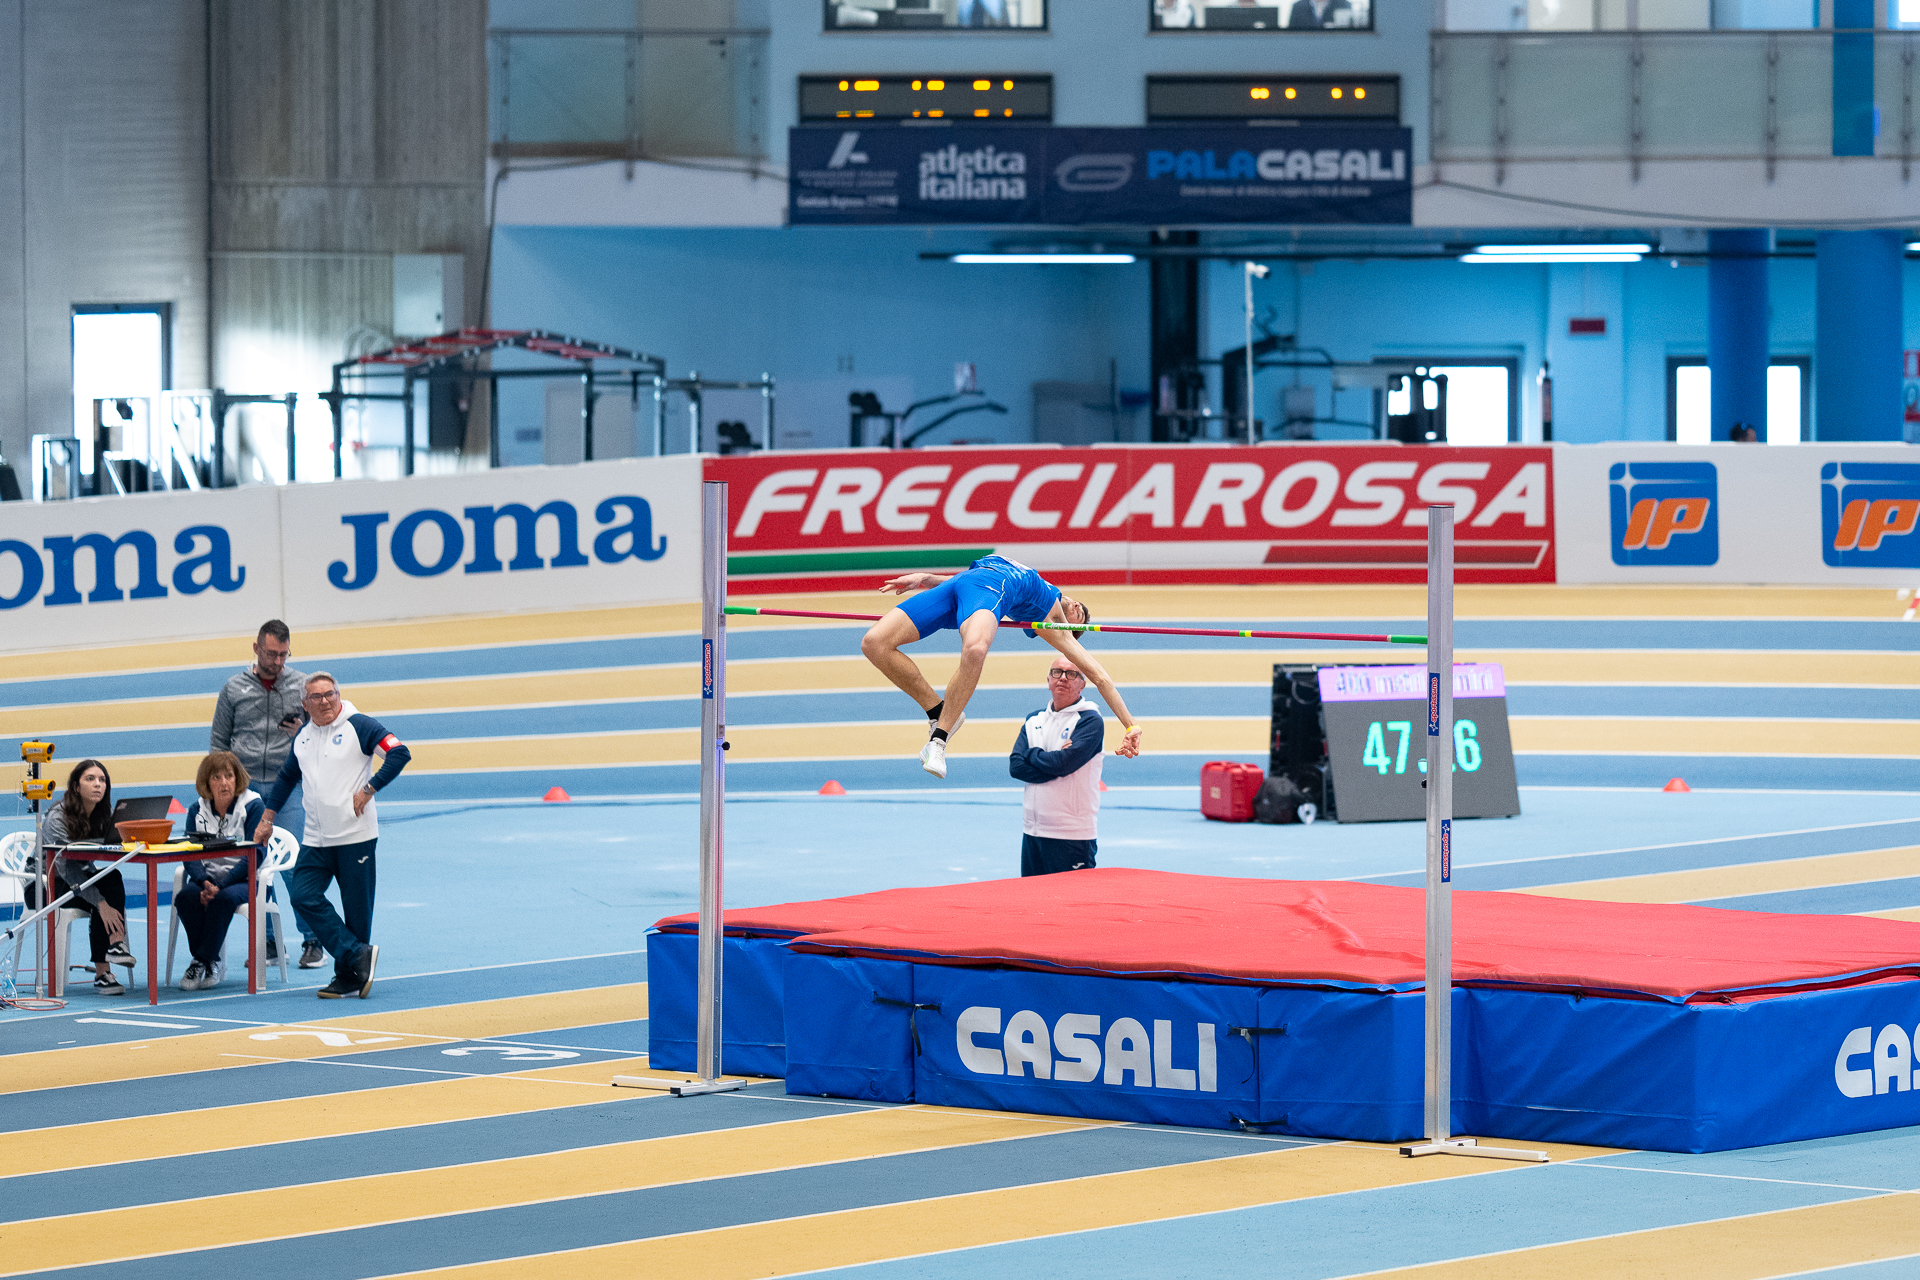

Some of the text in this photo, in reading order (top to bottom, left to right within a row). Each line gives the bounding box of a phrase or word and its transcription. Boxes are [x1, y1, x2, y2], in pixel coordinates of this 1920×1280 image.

[919, 143, 1026, 174] atletica
[1146, 149, 1406, 181] PALACASALI
[919, 169, 1026, 200] italiana
[733, 461, 1547, 538] FRECCIAROSSA
[1336, 672, 1370, 694] 400
[1375, 669, 1426, 693] metri
[1362, 718, 1483, 776] 47.6
[956, 1006, 1217, 1093] CASALI
[1834, 1023, 1920, 1099] CA
